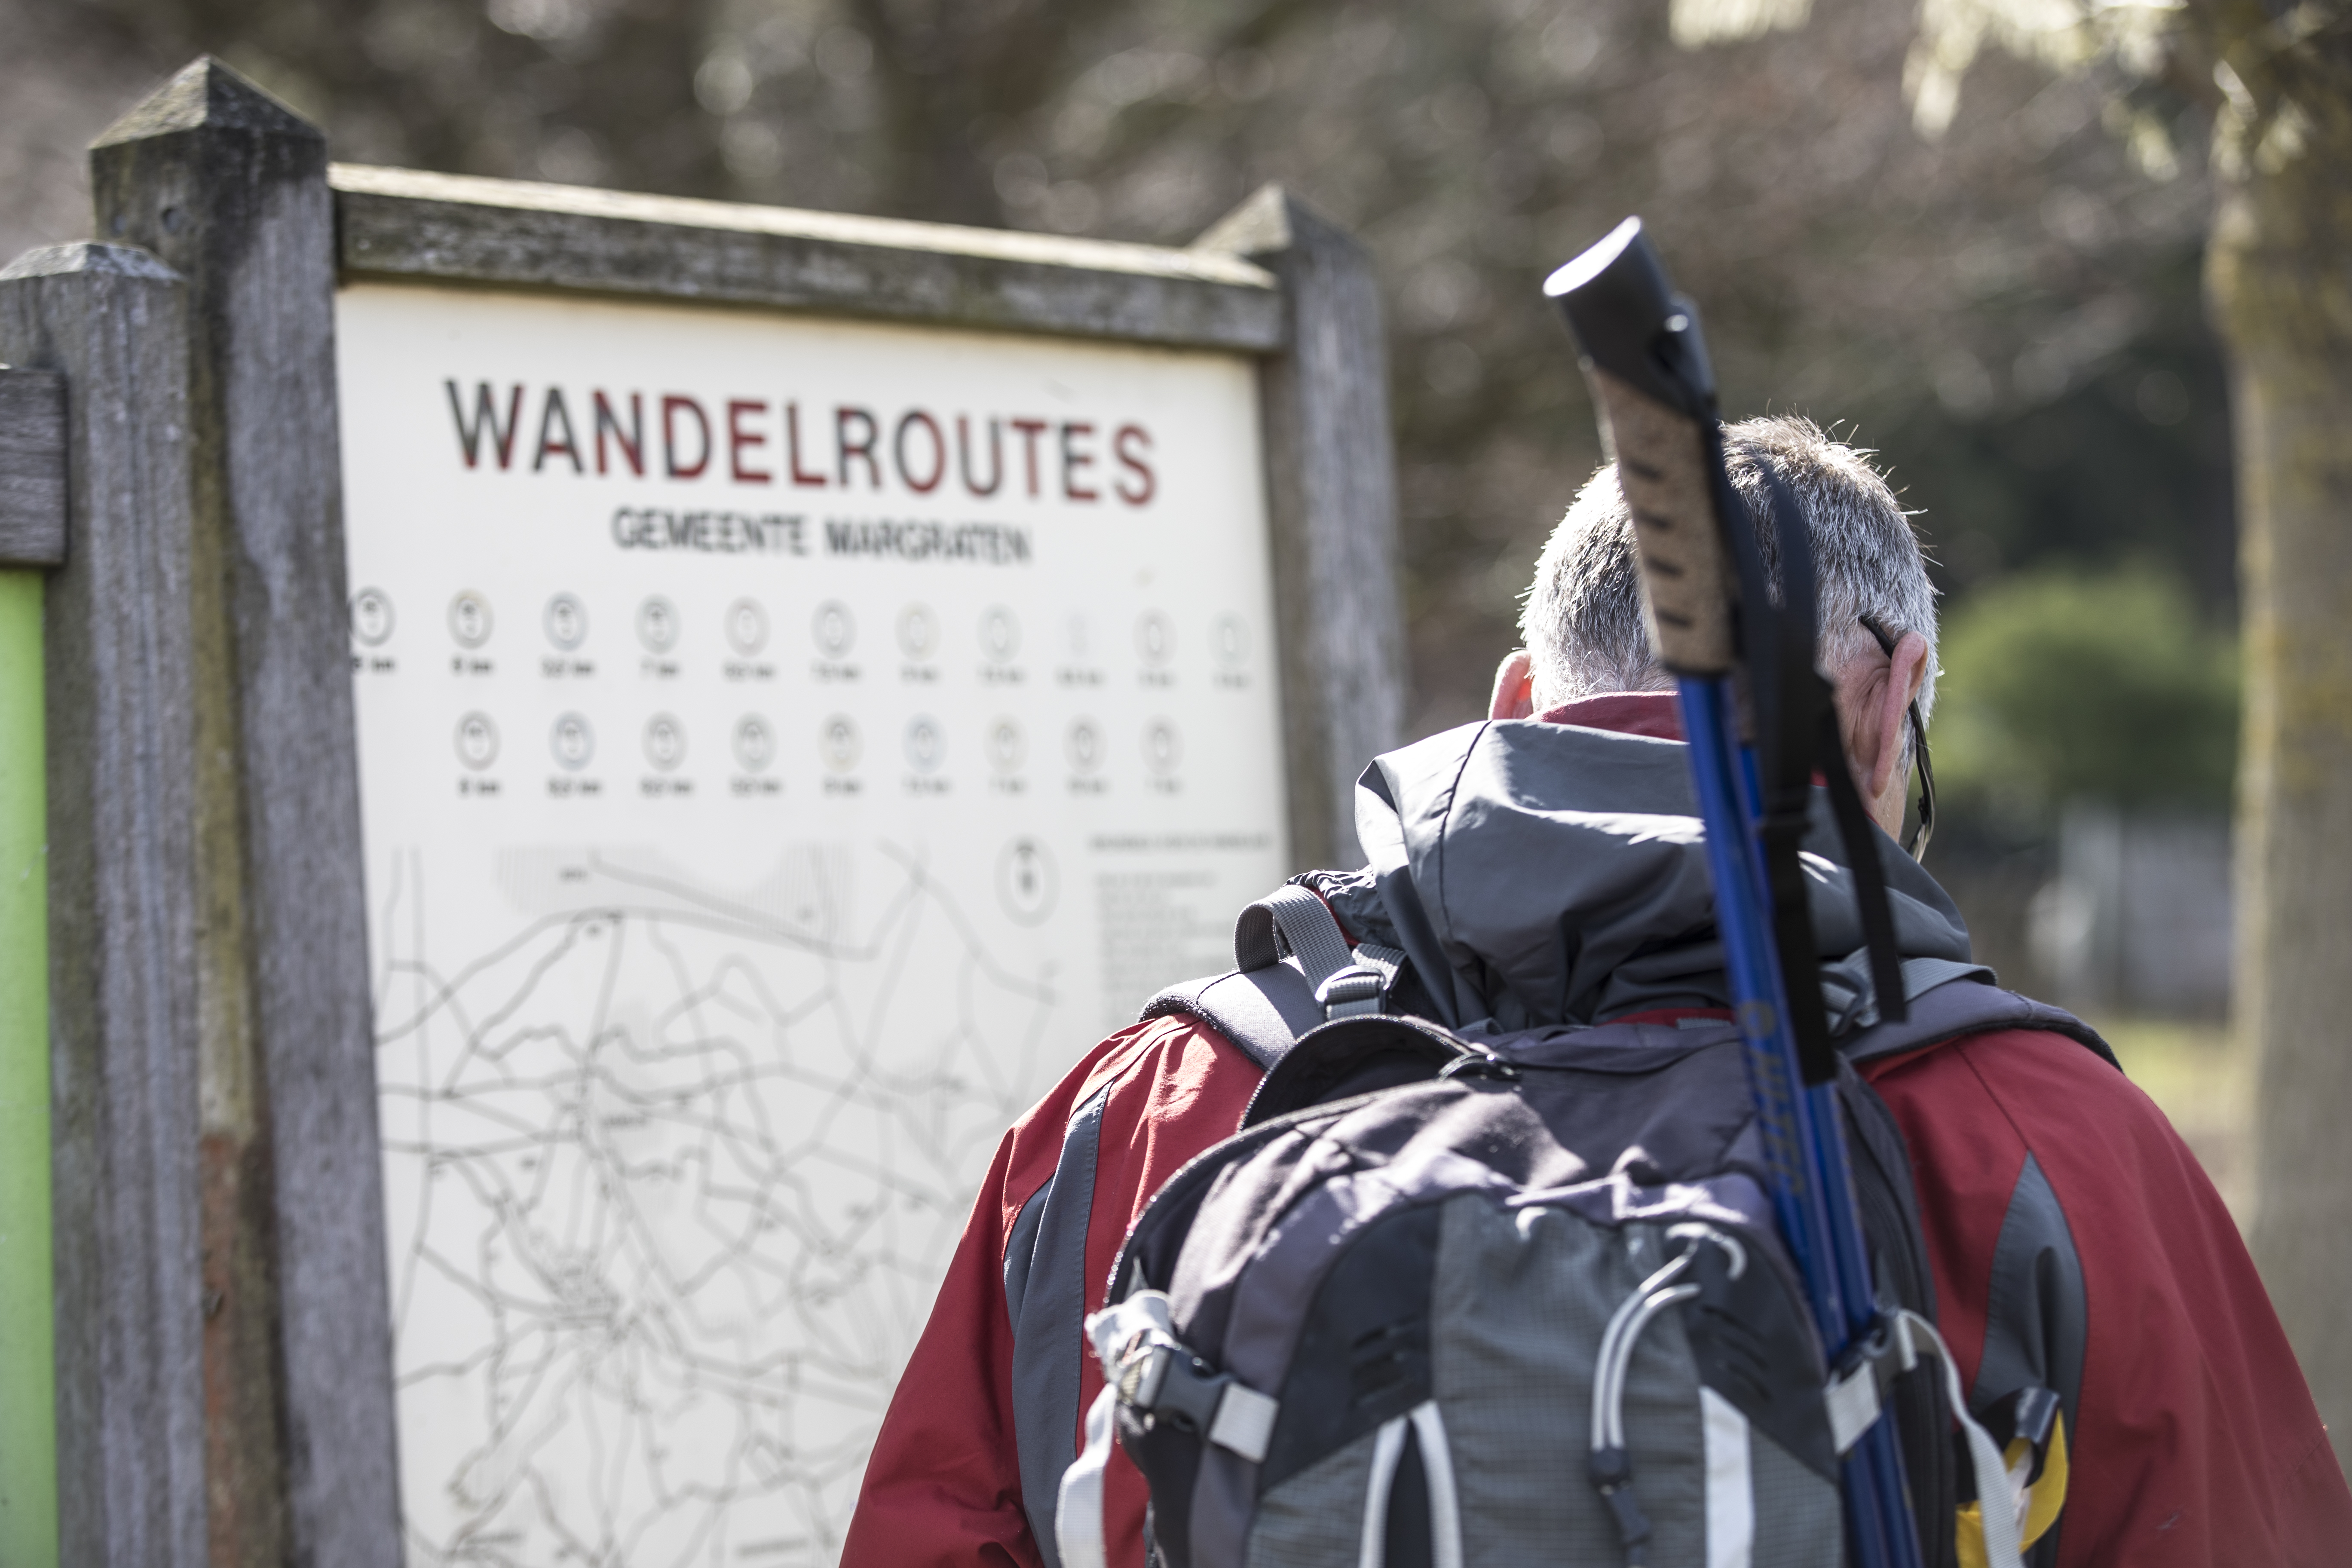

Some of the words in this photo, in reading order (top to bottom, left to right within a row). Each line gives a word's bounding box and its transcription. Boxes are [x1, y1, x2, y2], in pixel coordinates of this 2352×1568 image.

[441, 377, 1158, 509] WANDELROUTES
[612, 506, 809, 557] GEMEENTE
[824, 519, 1033, 567] MARGRATEN
